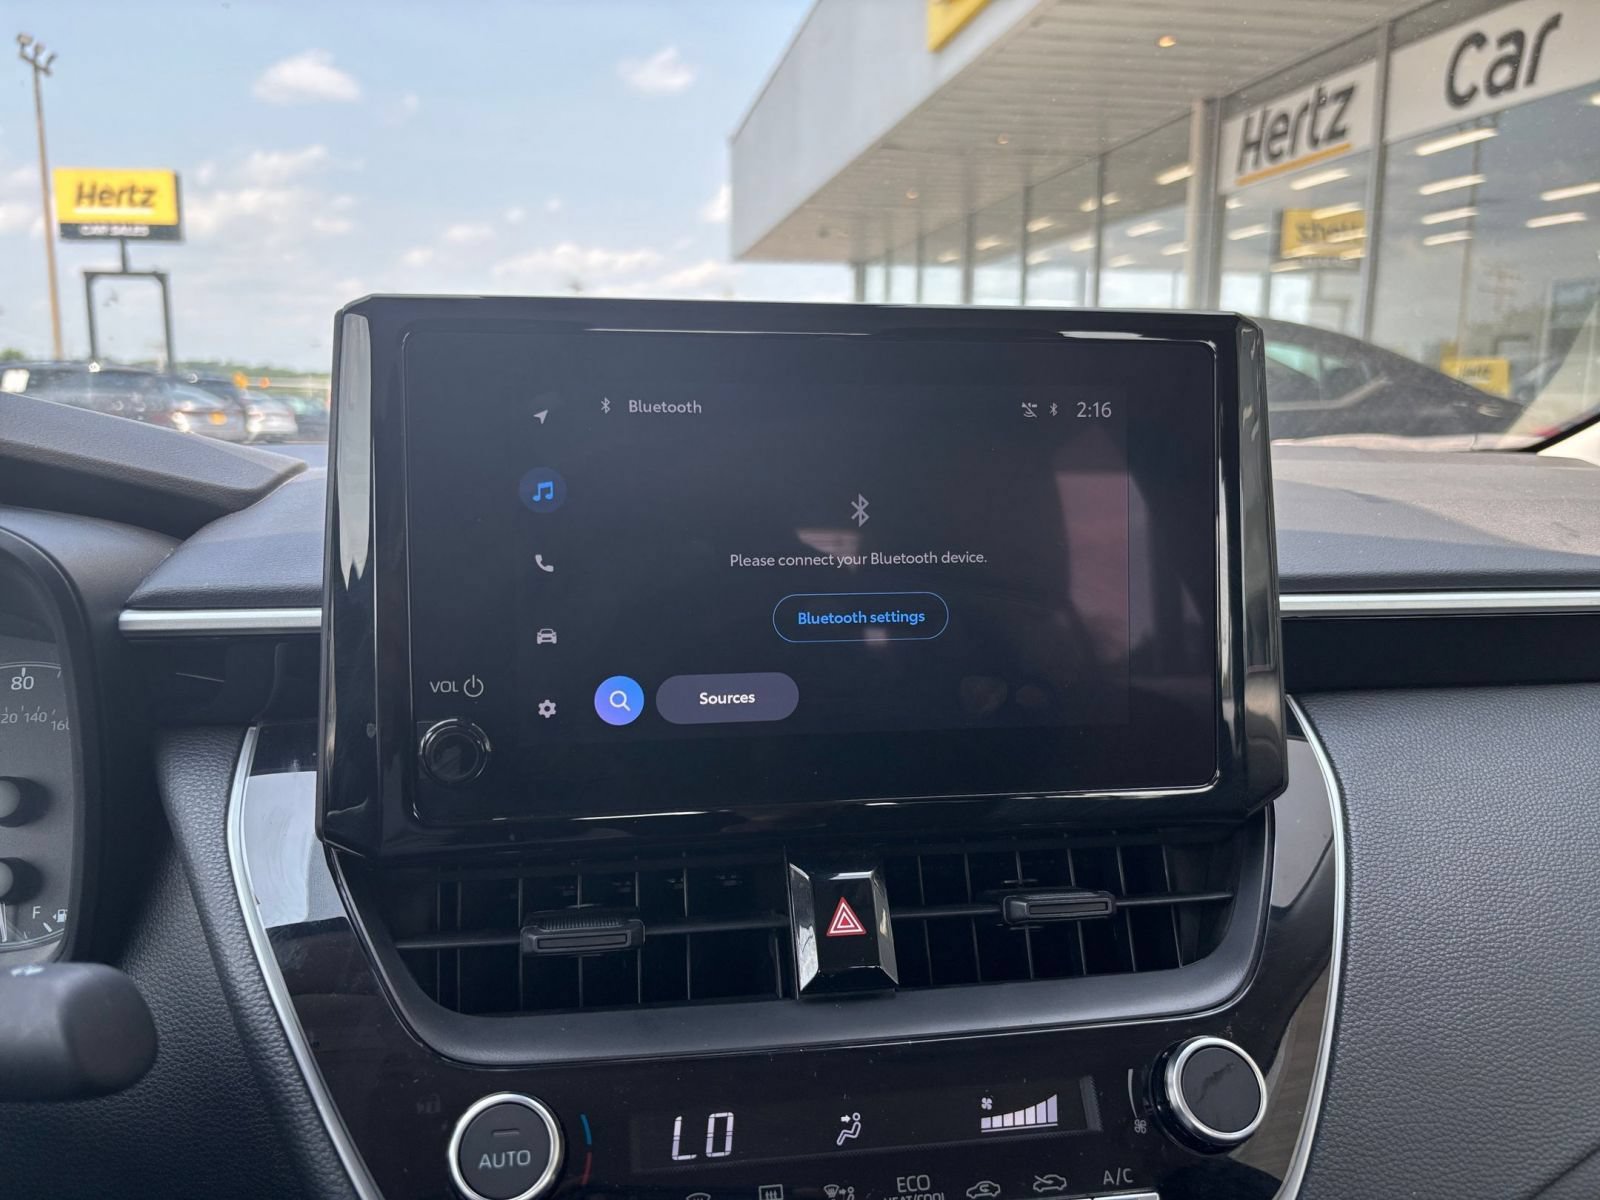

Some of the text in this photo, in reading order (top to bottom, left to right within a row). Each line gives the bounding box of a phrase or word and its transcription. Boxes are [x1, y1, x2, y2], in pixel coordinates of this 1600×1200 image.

[1237, 12, 1562, 173] Hertz Car
[75, 181, 157, 208] Hertz
[628, 399, 703, 414] Bluetooth
[1076, 401, 1112, 418] 2:16
[729, 550, 989, 569] Please connect your Bluetooth device.
[797, 610, 926, 626] Bluetooth settings
[10, 676, 35, 691] 80
[429, 680, 459, 694] VOL
[699, 692, 756, 705] Sources
[0, 712, 18, 724] 20
[23, 711, 48, 723] 140
[32, 905, 42, 920] F
[478, 1149, 532, 1170] AUTO
[896, 1174, 931, 1193] ECO
[1102, 1167, 1134, 1186] A/C
